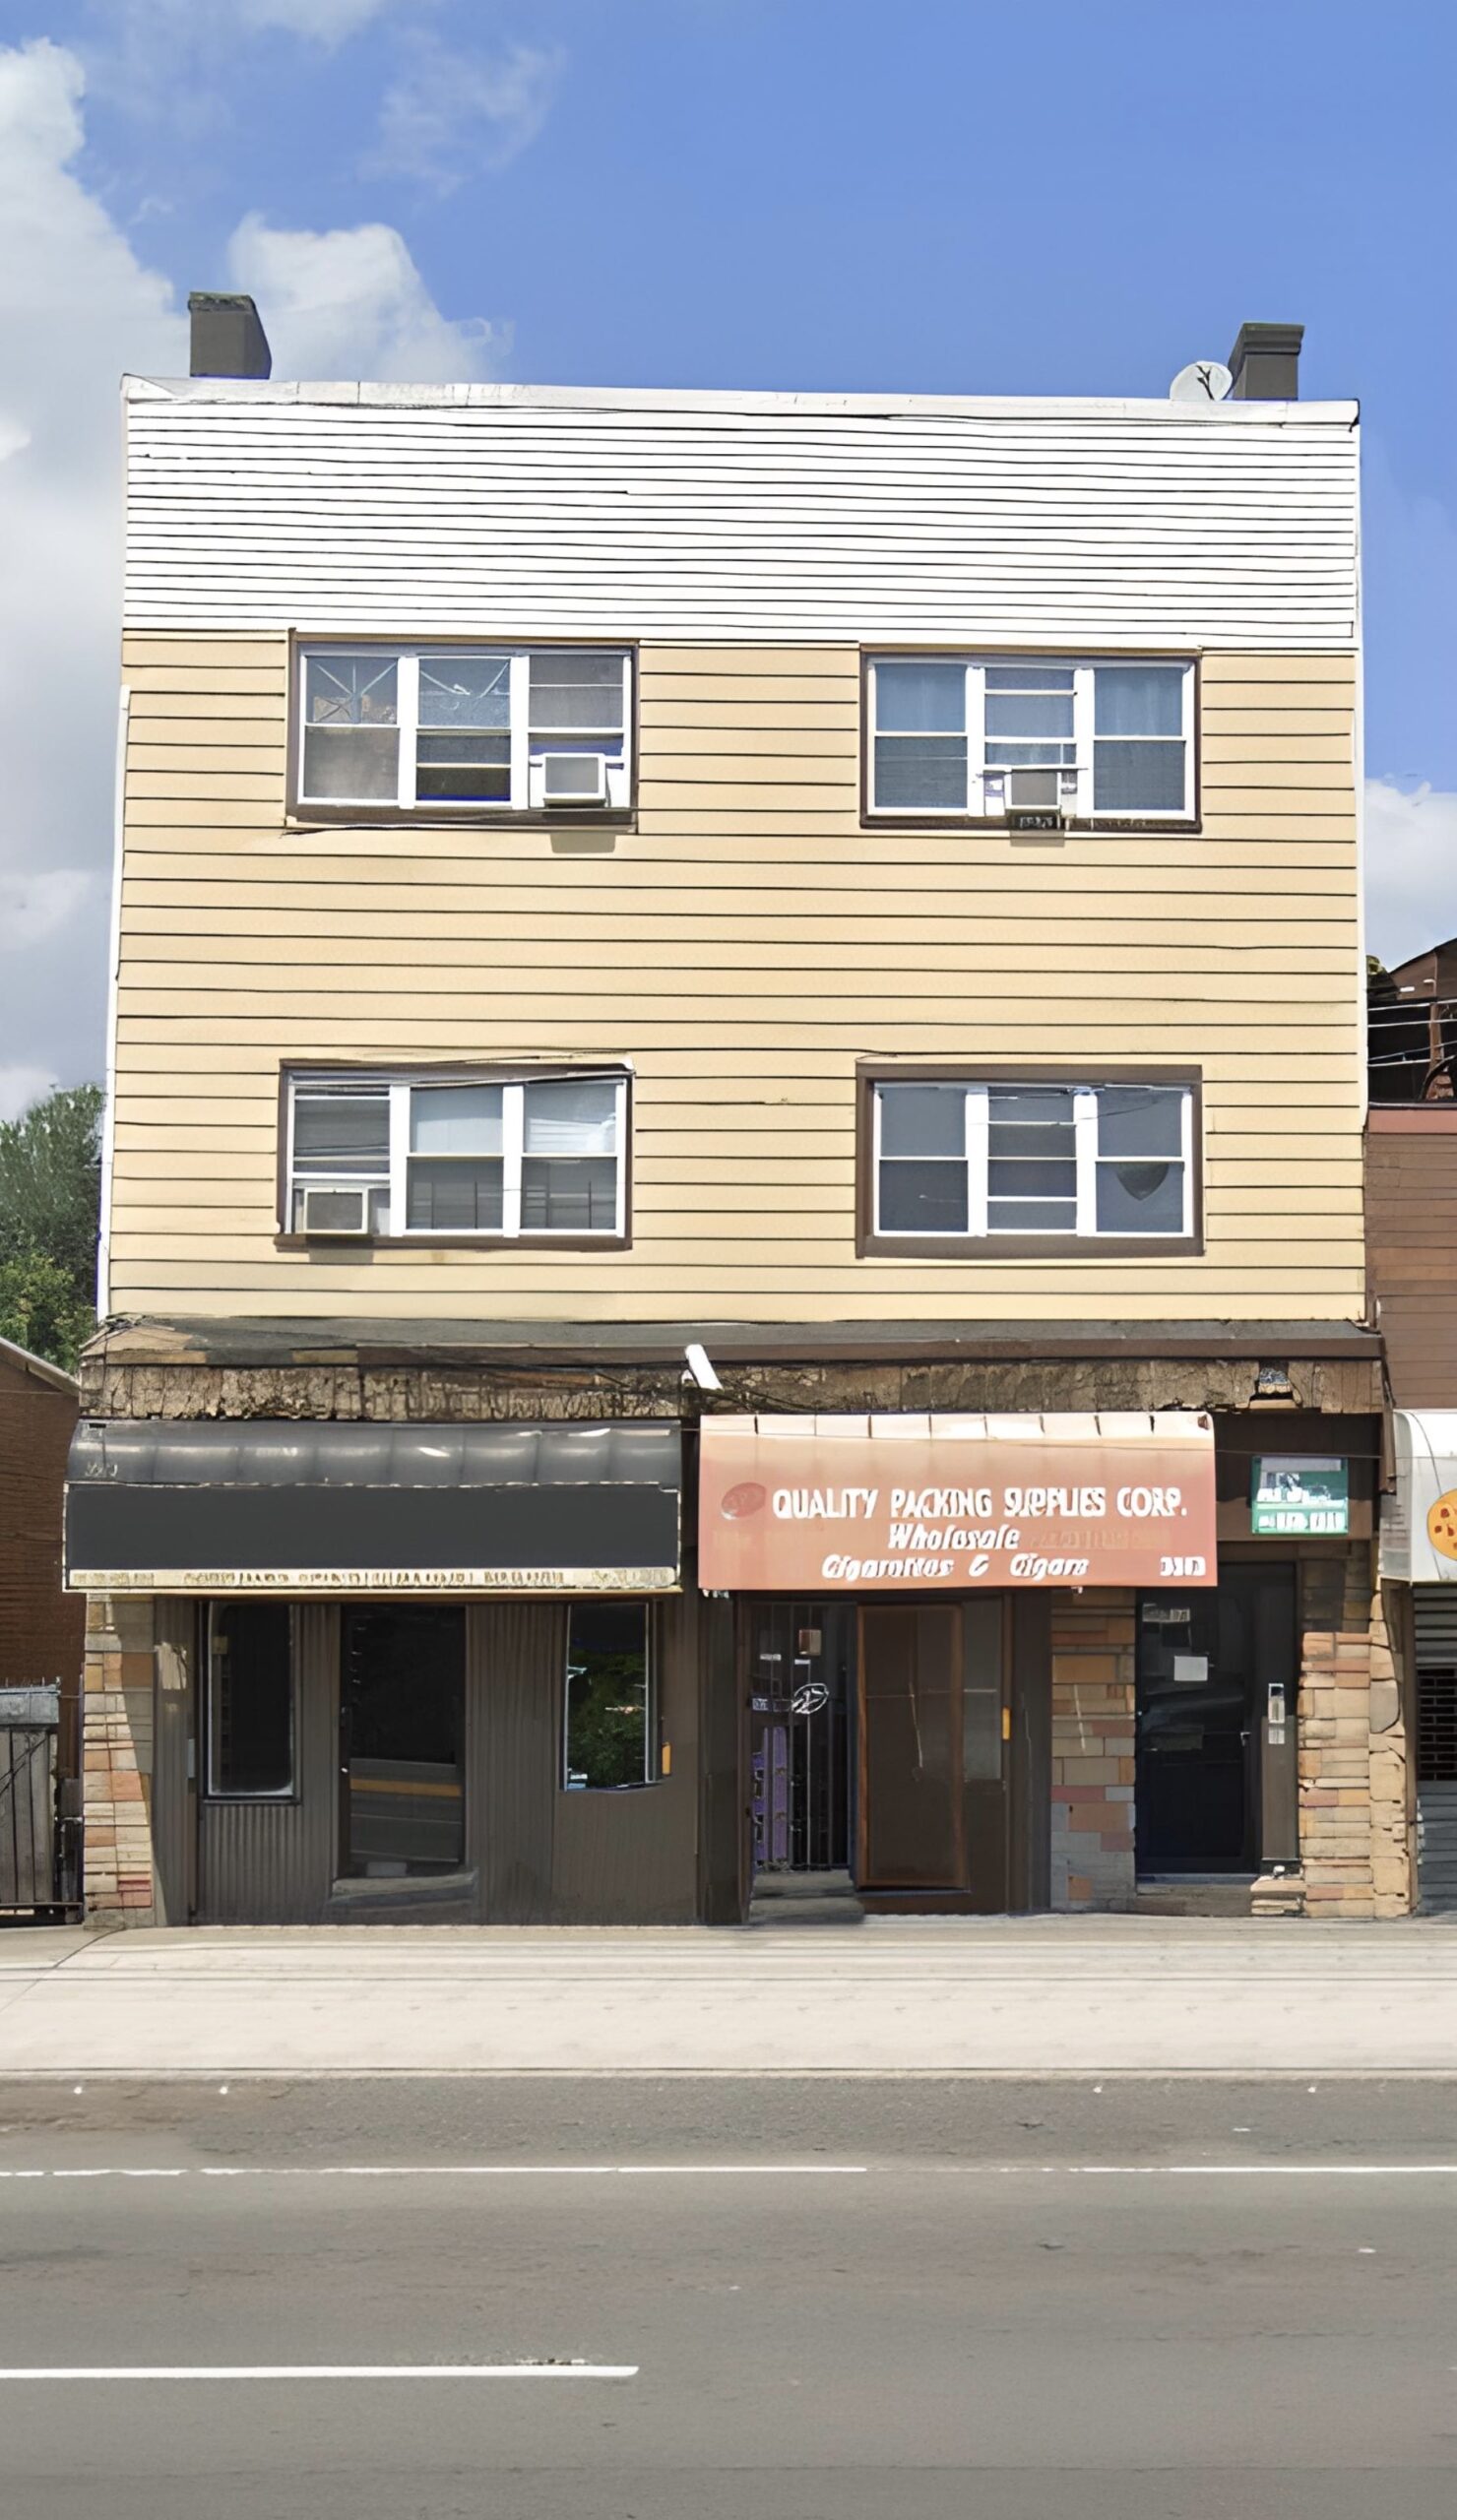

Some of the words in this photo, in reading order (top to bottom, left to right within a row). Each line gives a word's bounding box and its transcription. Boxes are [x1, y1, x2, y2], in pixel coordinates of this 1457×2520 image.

[773, 1487, 879, 1519] QUALITY
[890, 1487, 993, 1518] PACKING
[1116, 1486, 1187, 1517] CORP.
